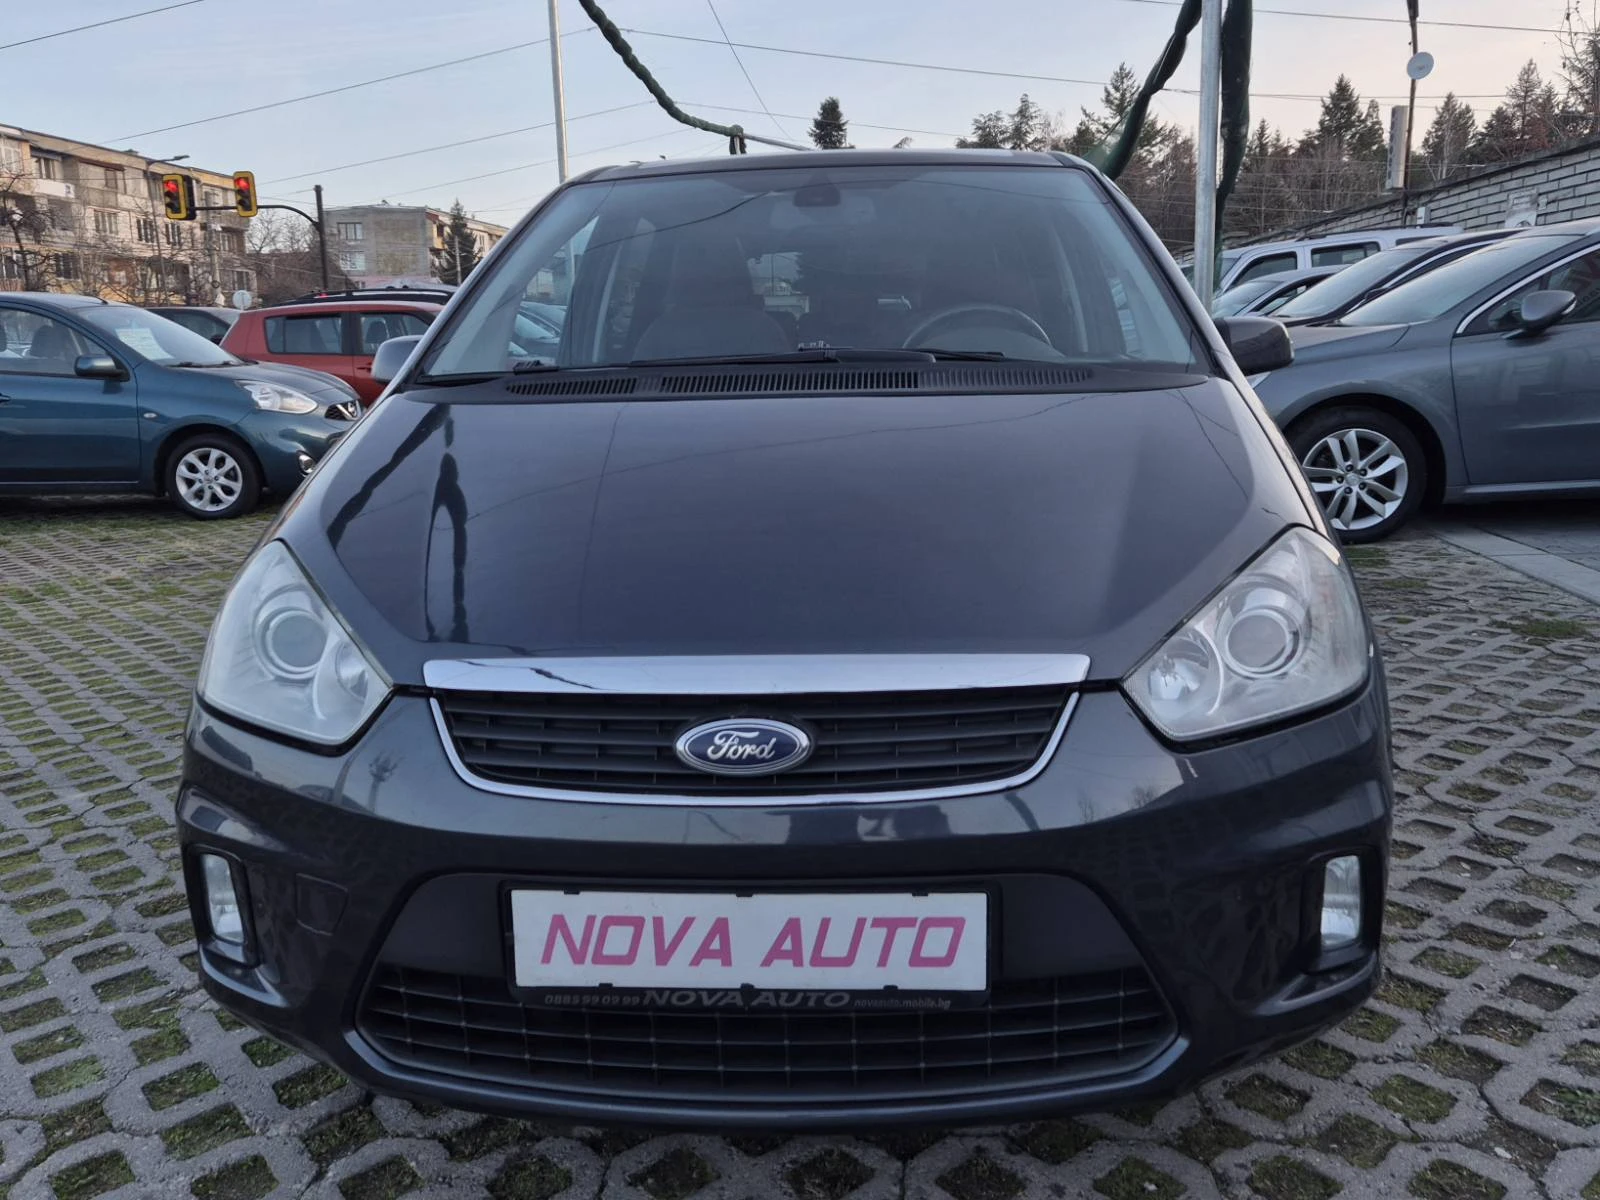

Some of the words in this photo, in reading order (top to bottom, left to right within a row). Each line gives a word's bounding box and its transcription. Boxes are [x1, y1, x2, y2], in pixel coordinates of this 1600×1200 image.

[707, 730, 777, 760] Ford
[541, 914, 733, 967] NOVA
[760, 917, 967, 968] AUTO
[642, 990, 744, 1007] NOVA
[750, 991, 850, 1007] AUTO
